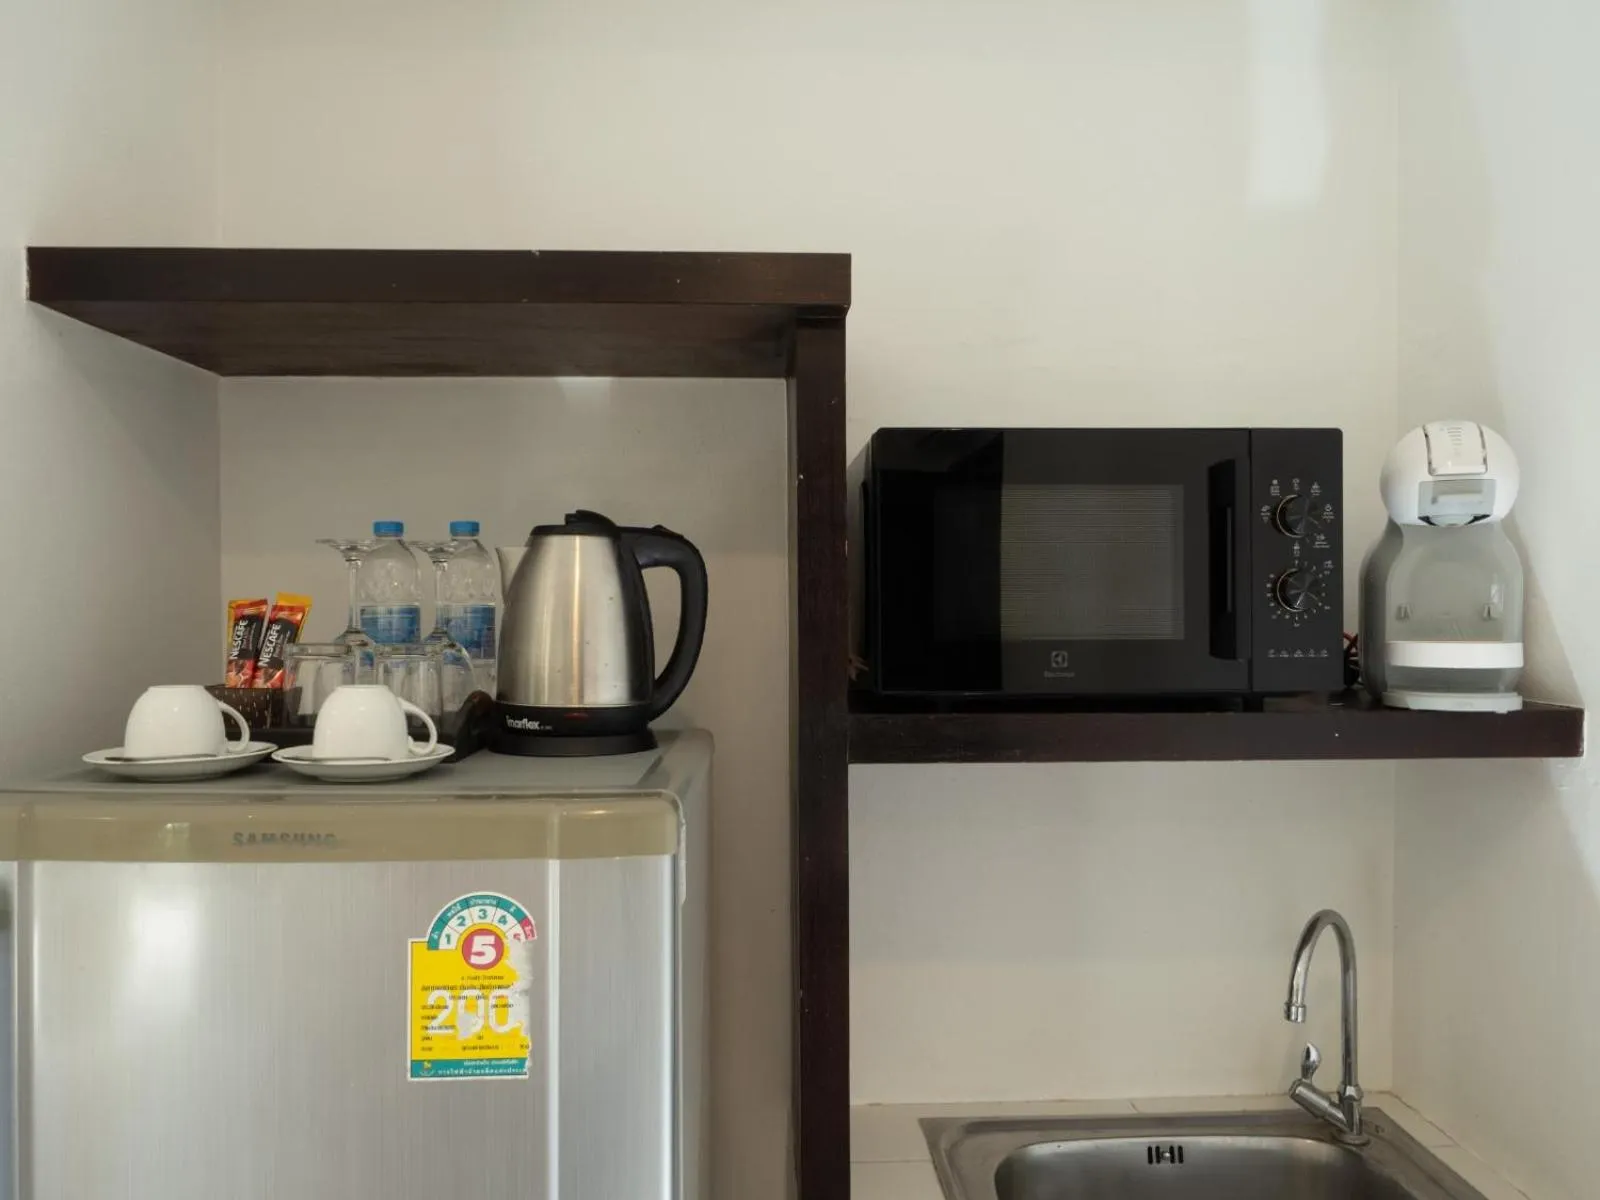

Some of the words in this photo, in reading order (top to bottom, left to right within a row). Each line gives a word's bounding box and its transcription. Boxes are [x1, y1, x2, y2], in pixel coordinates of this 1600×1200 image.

[231, 831, 337, 847] SAMSUNG
[444, 933, 452, 945] 1
[456, 915, 467, 927] 2
[477, 908, 488, 920] 3
[497, 914, 508, 926] 4
[469, 935, 497, 965] 5
